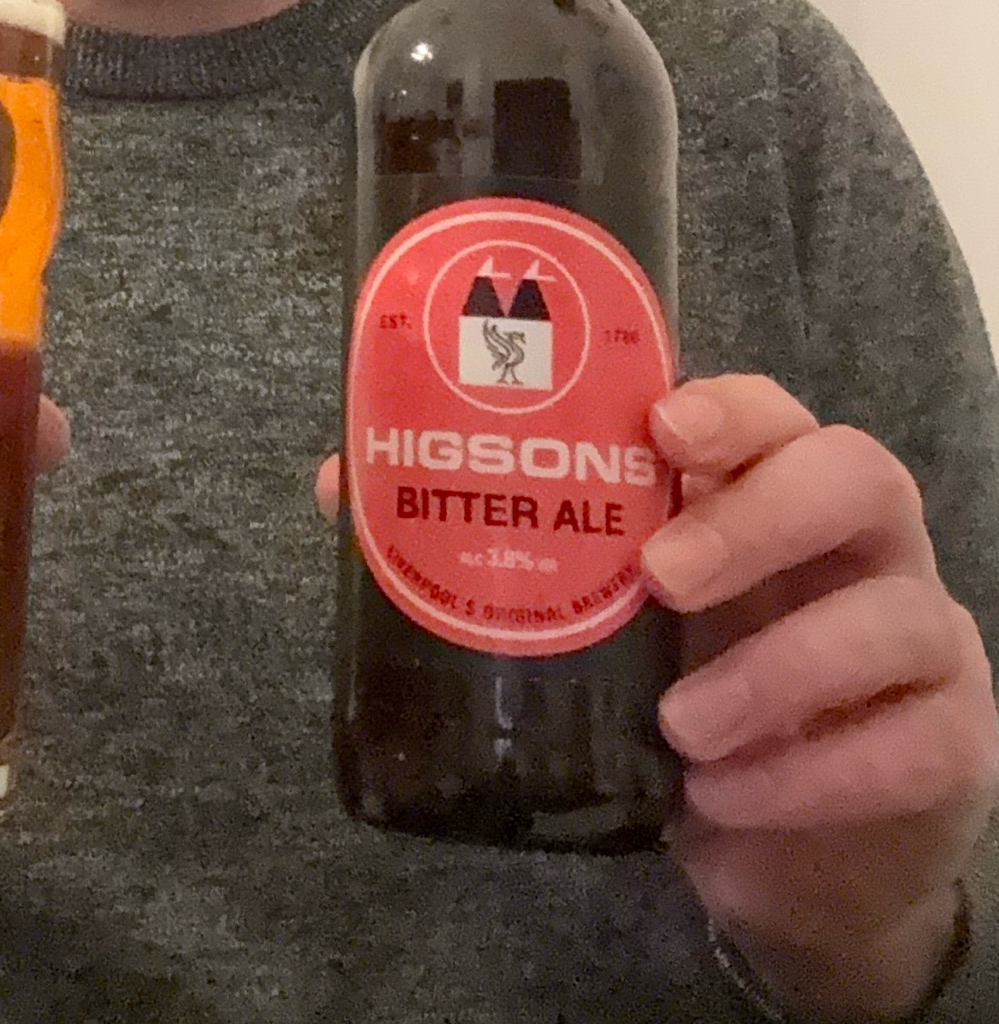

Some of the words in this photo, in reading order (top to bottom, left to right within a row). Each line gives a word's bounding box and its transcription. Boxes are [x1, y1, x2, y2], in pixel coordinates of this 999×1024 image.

[365, 427, 655, 486] HIGSONS
[396, 486, 539, 529] BITTER
[553, 499, 625, 536] ALE
